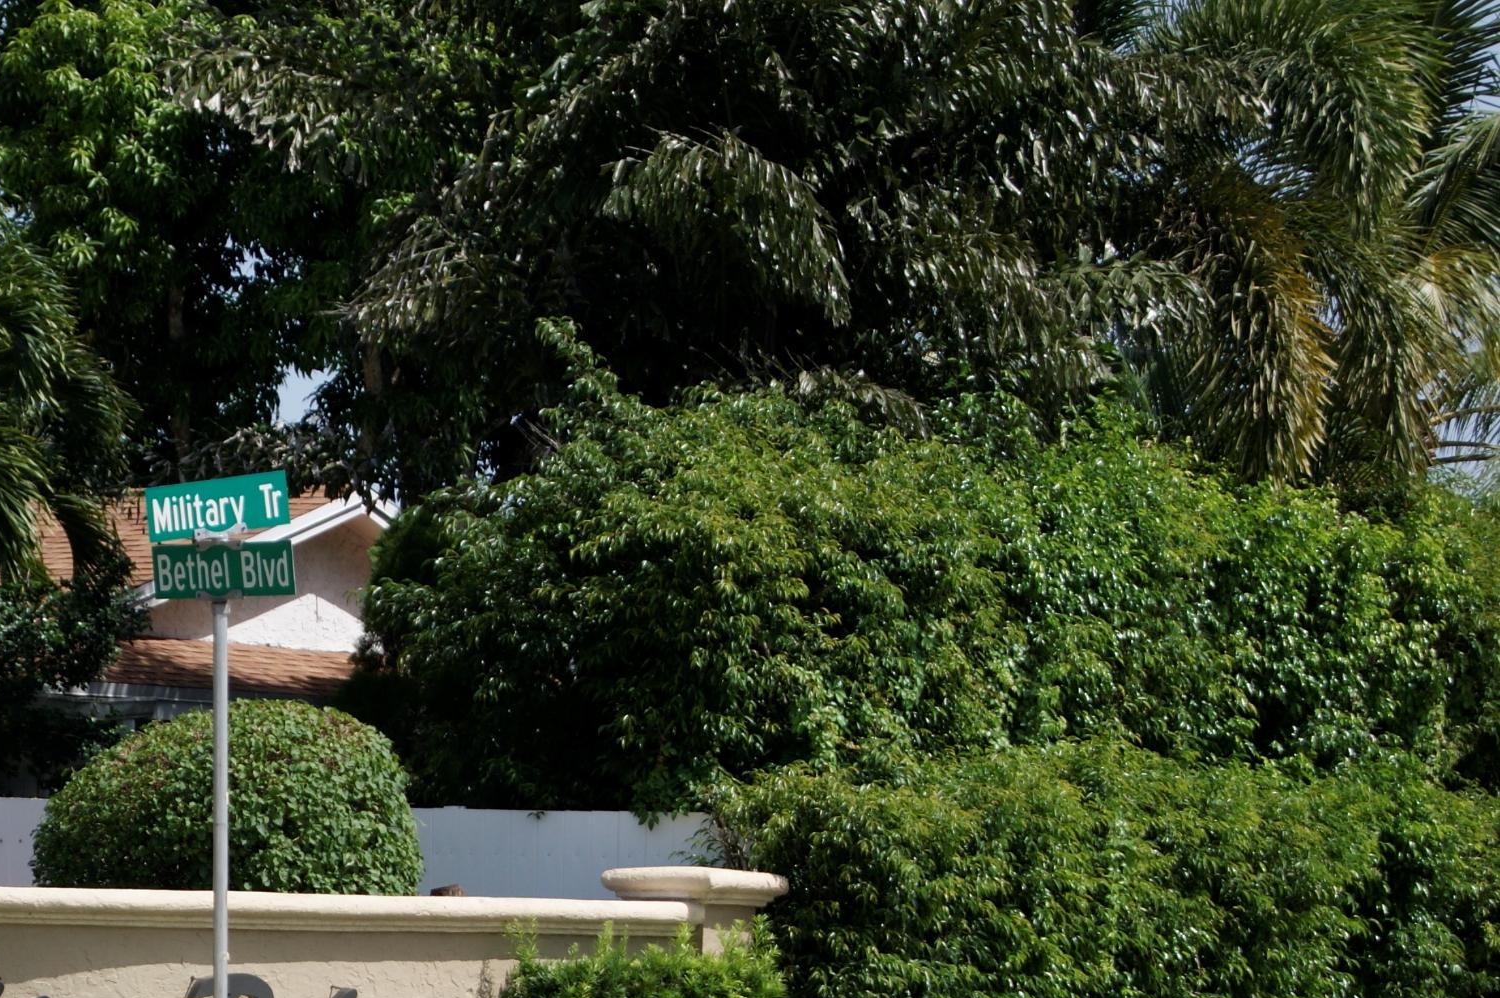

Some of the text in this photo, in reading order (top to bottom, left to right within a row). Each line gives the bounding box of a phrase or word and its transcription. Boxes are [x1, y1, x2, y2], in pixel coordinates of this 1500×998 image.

[152, 483, 282, 534] Military Tr
[157, 550, 290, 592] Bethel Blvd
